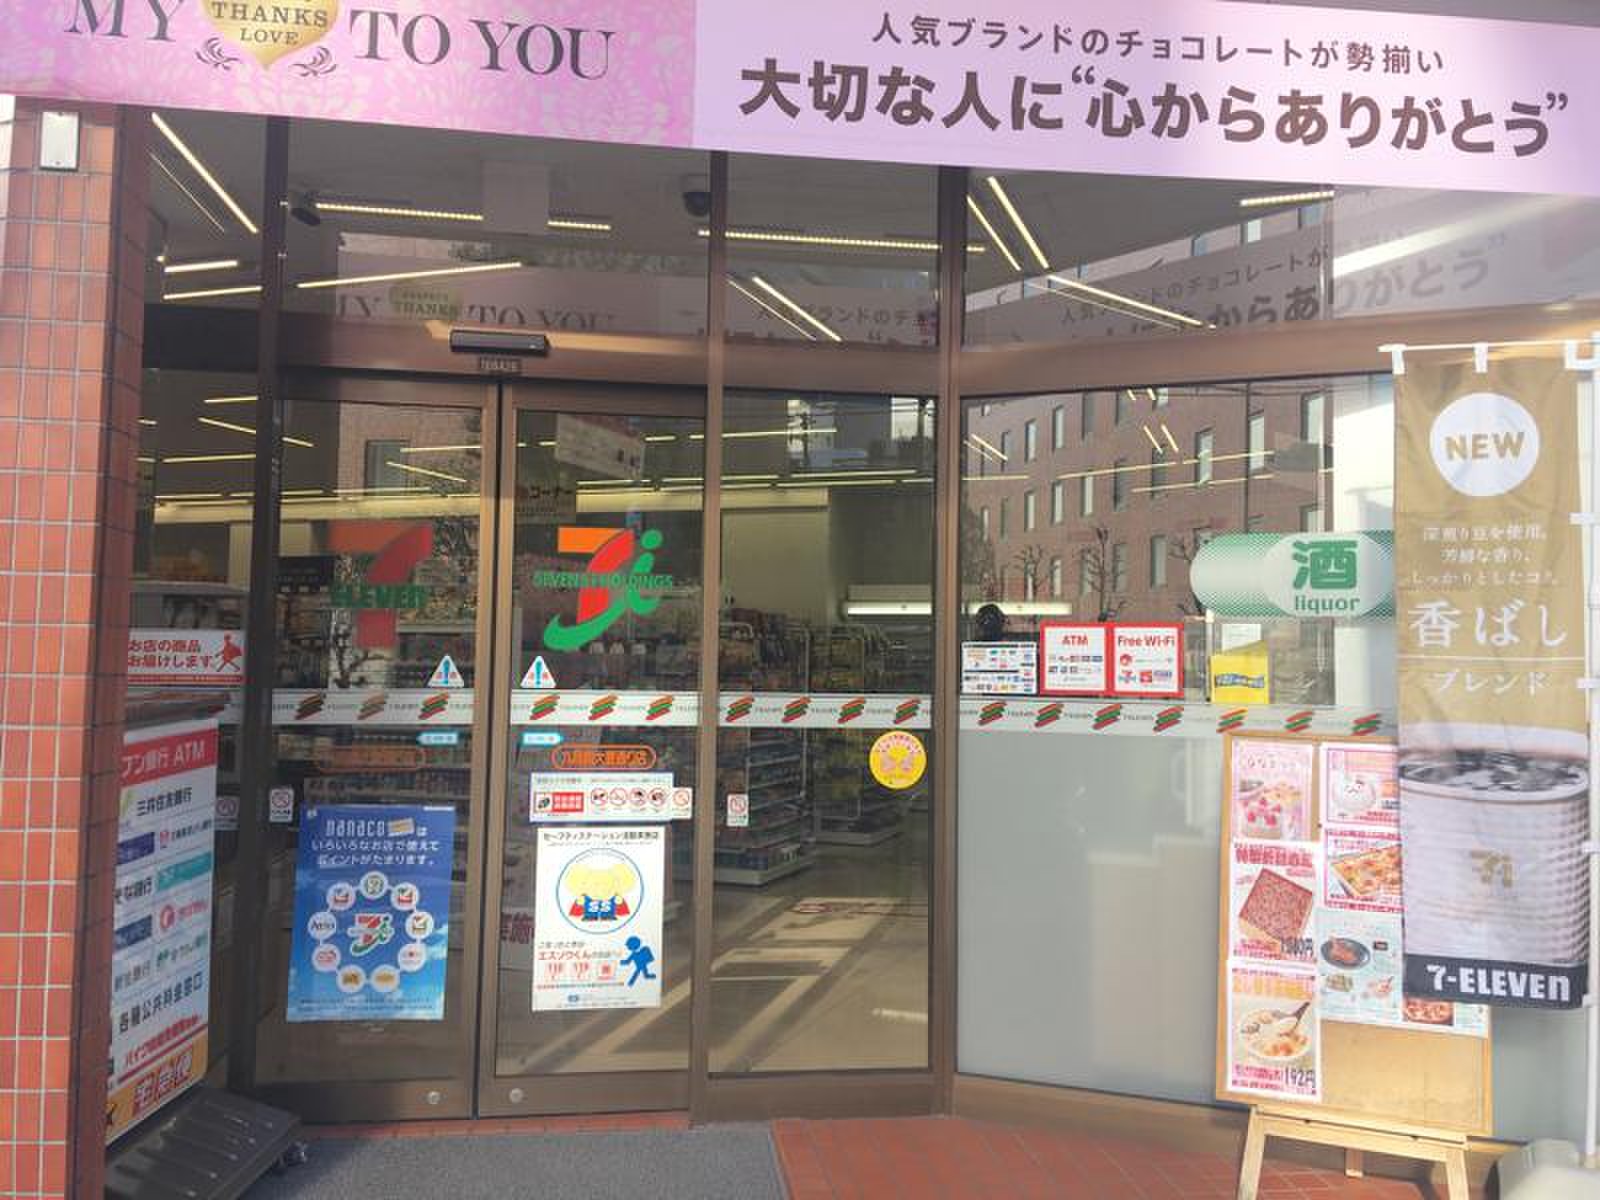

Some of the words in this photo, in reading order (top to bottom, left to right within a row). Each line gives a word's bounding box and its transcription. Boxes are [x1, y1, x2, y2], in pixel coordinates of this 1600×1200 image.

[64, 0, 185, 42] MY
[212, 1, 329, 28] THANKS
[239, 27, 300, 46] LOVE
[349, 8, 452, 65] TO
[469, 18, 616, 81] YOU
[872, 11, 1445, 75] 人気ブランドのチョコレートが勢揃い
[1444, 431, 1525, 462] NEW
[1293, 539, 1359, 590] 酒
[1294, 596, 1360, 613] liquor
[1408, 598, 1567, 648] 香ばし
[1061, 634, 1089, 646] ATM
[1118, 634, 1143, 647] Free
[174, 740, 205, 765] ATM
